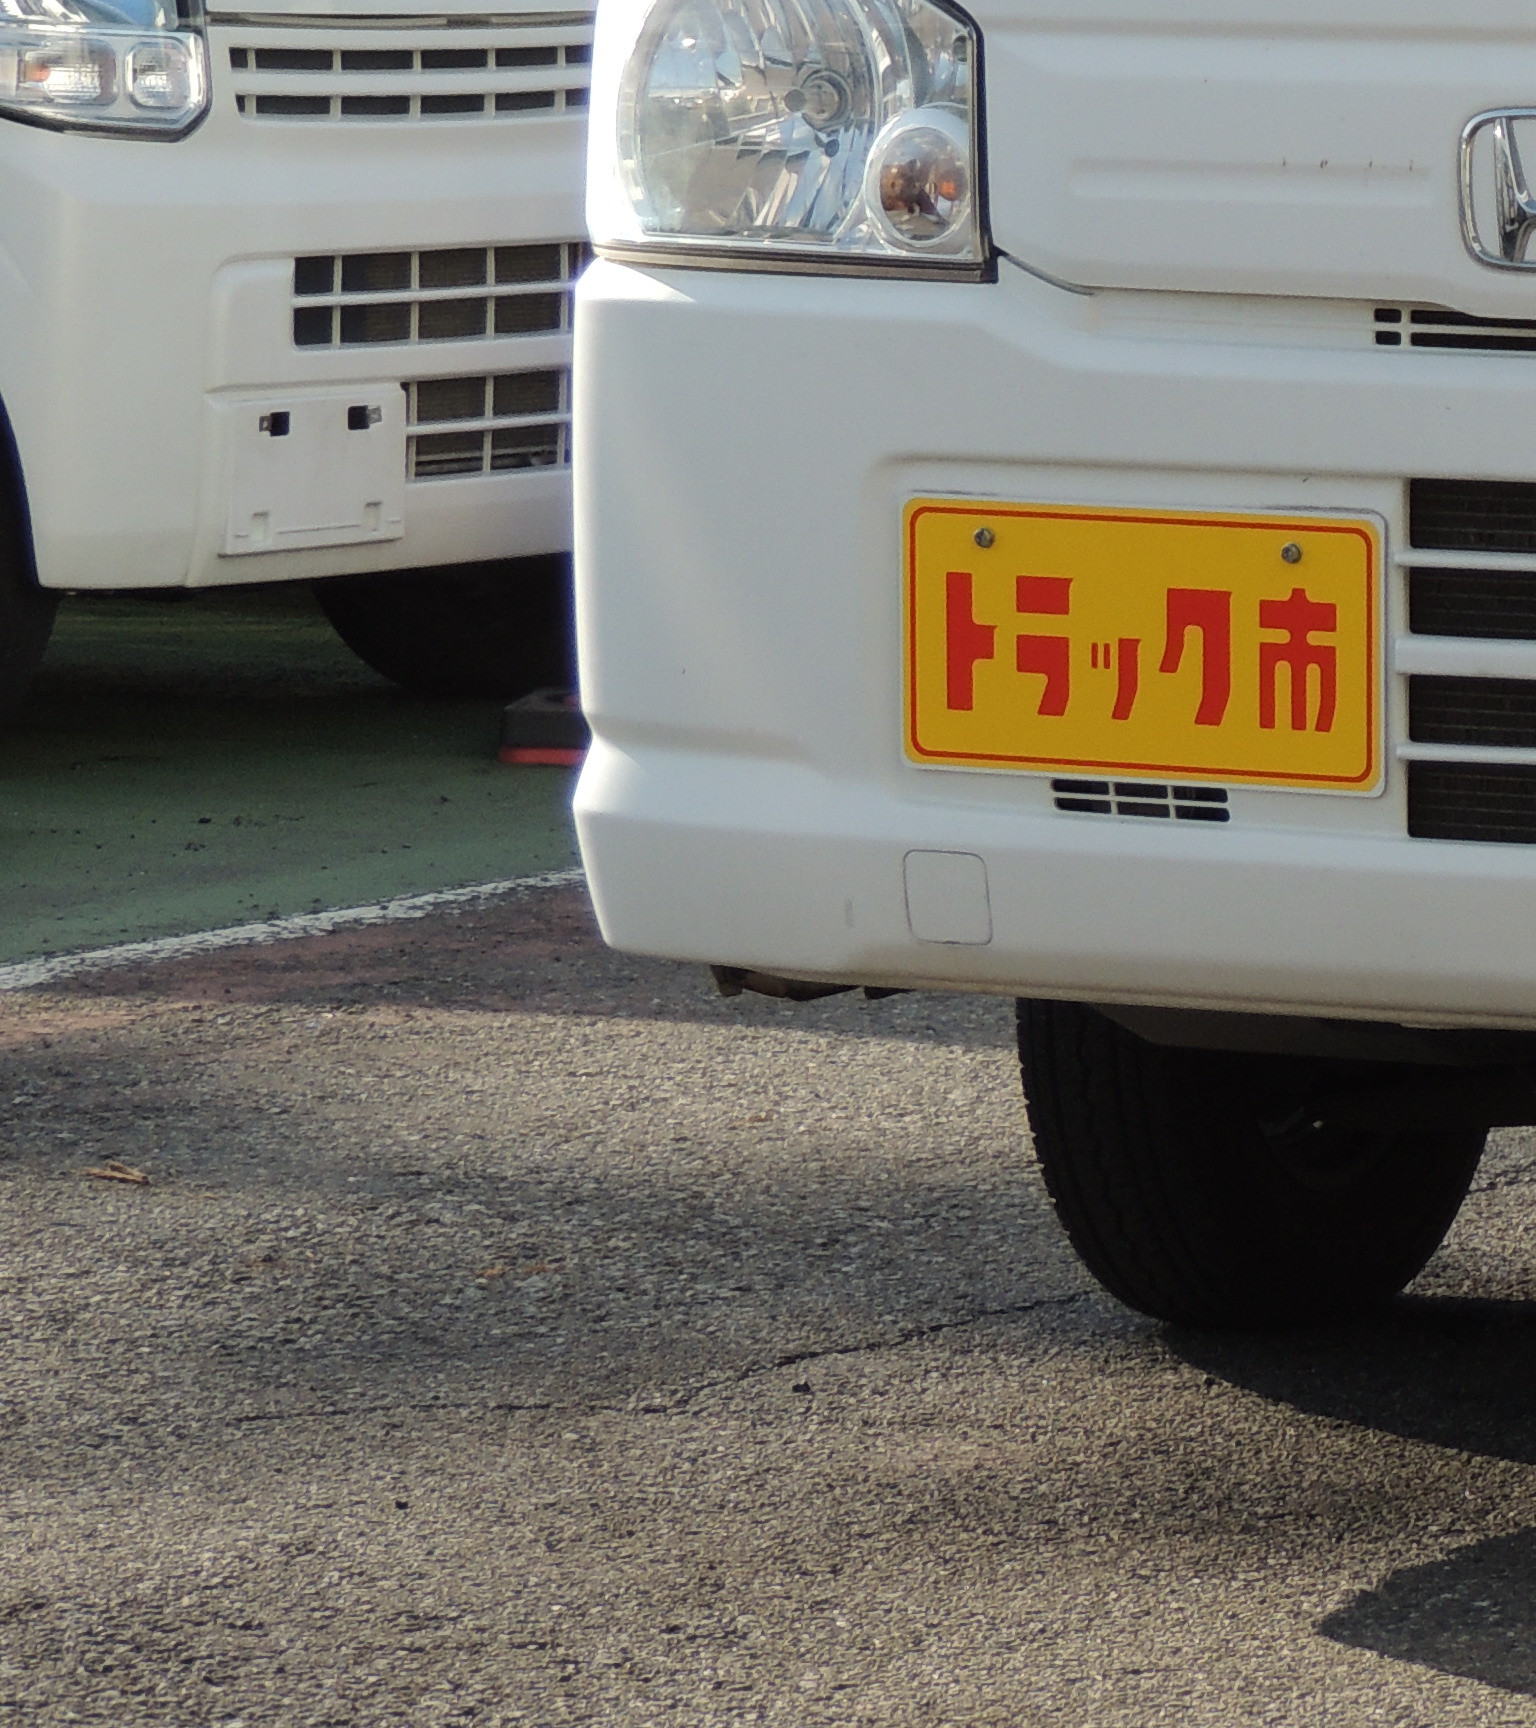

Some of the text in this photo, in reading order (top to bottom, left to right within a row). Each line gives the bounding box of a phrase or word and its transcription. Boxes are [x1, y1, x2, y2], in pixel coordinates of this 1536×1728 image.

[945, 571, 1338, 733] トラック市
